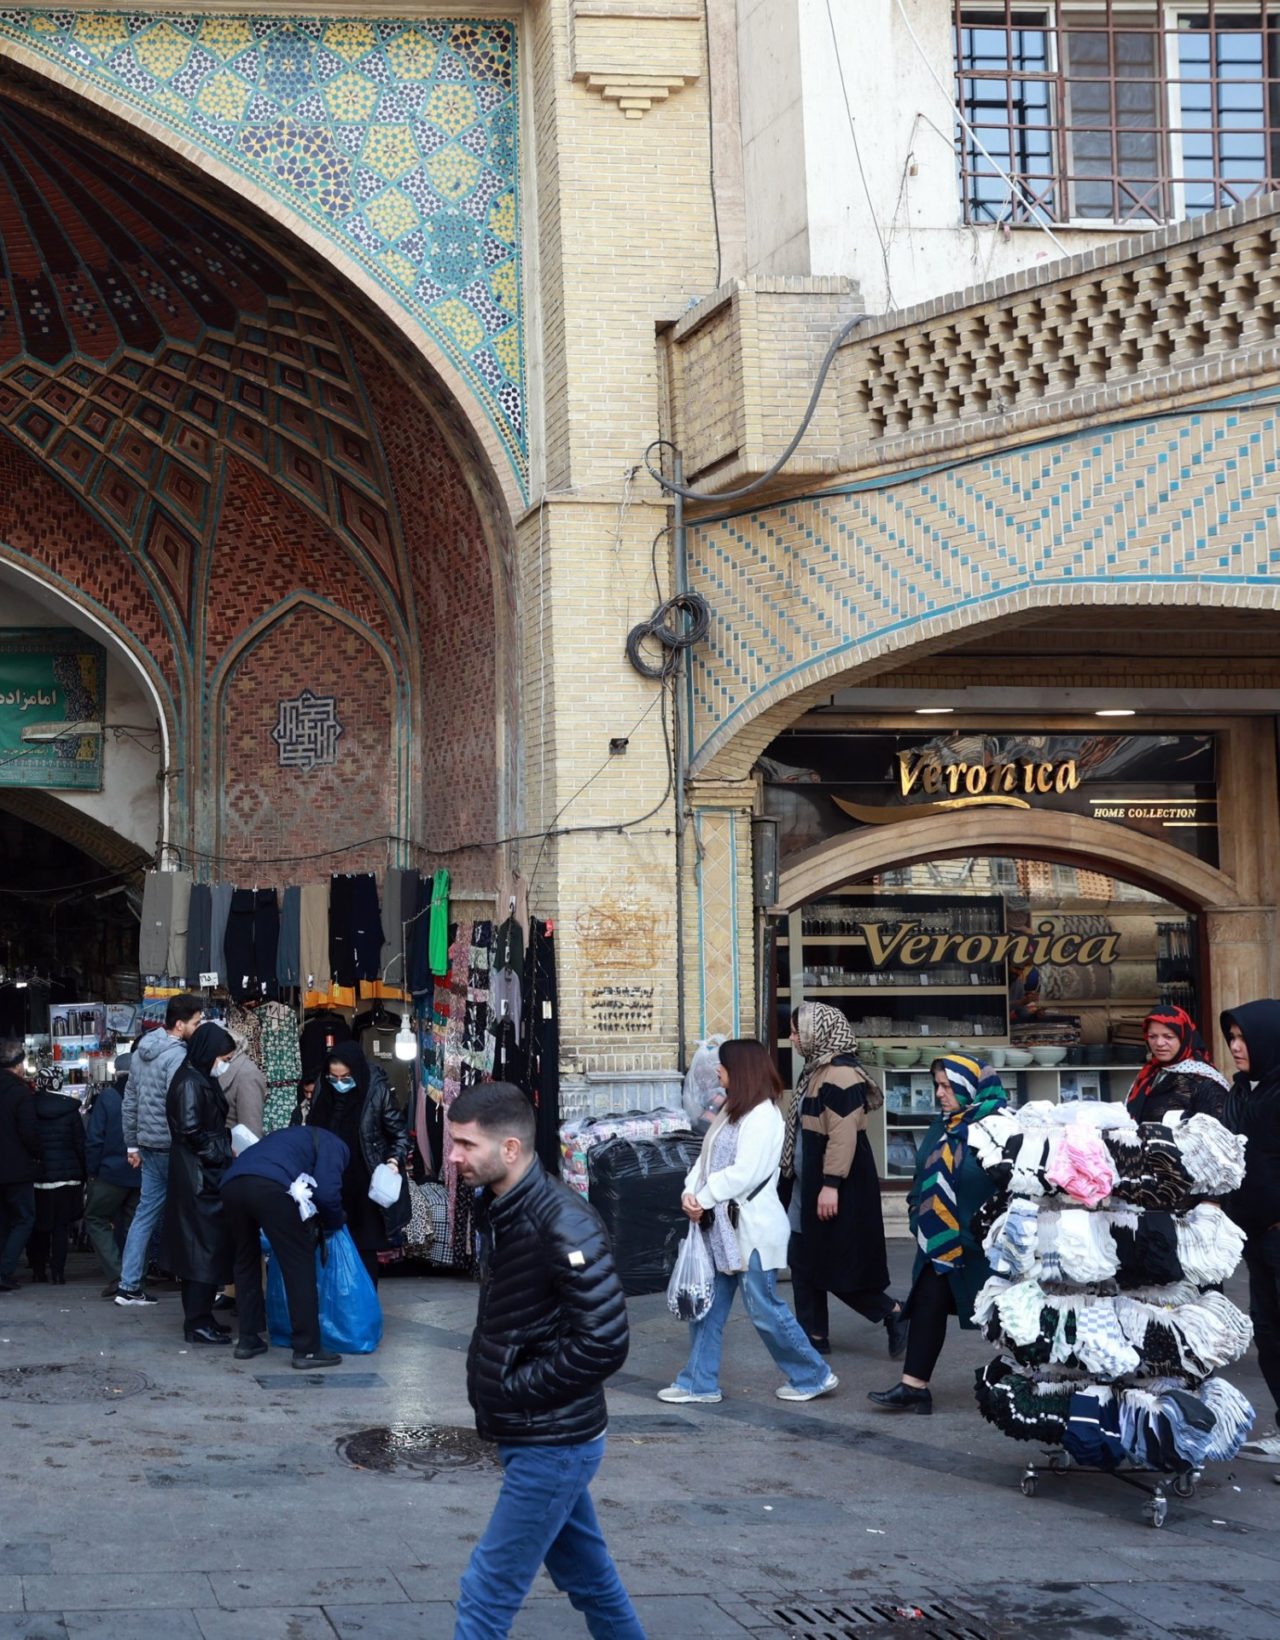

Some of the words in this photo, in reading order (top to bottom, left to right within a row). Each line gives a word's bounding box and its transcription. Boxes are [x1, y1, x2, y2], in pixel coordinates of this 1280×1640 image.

[1093, 808, 1125, 818] HOME
[1127, 808, 1197, 818] COLLECTION
[859, 919, 1121, 968] Veronica
